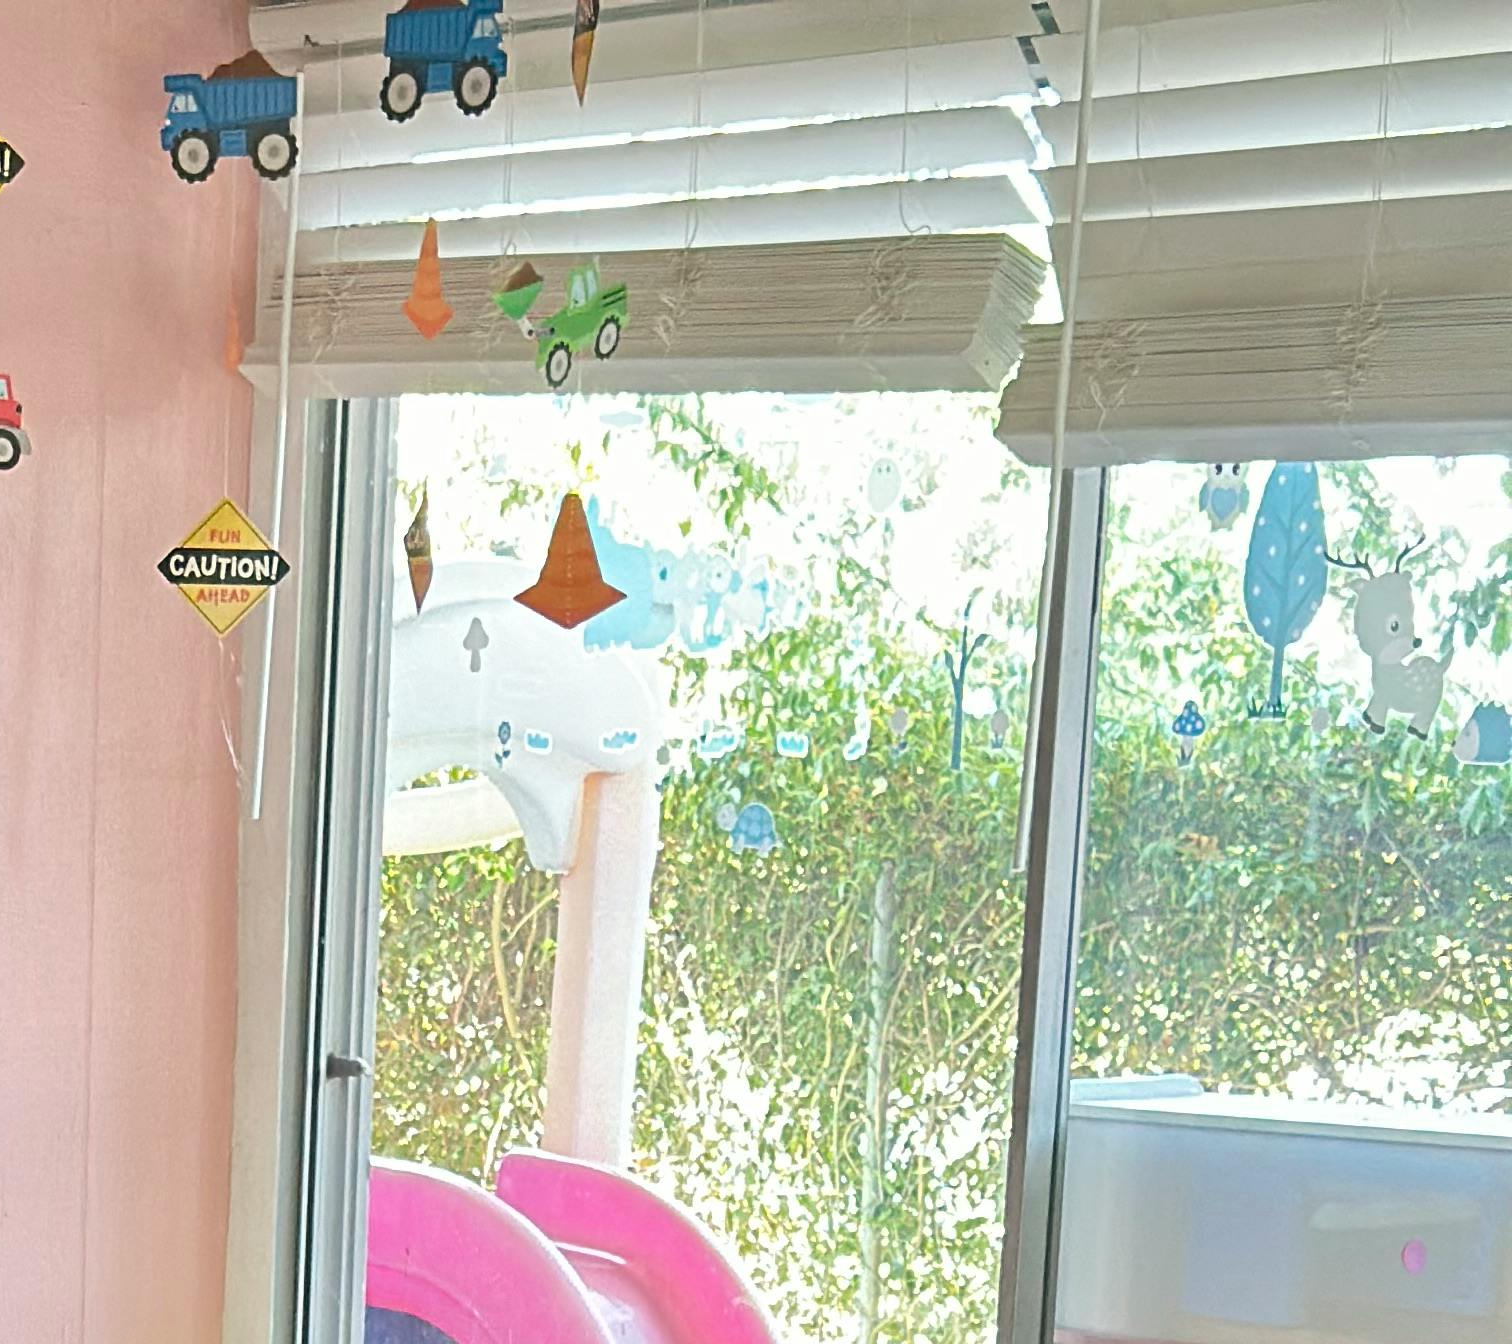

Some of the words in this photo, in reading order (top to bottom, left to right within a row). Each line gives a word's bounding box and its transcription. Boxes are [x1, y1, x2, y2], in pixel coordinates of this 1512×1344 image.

[209, 528, 241, 544] FUN
[169, 554, 279, 581] CAUTION!
[195, 588, 250, 606] AHEAD
